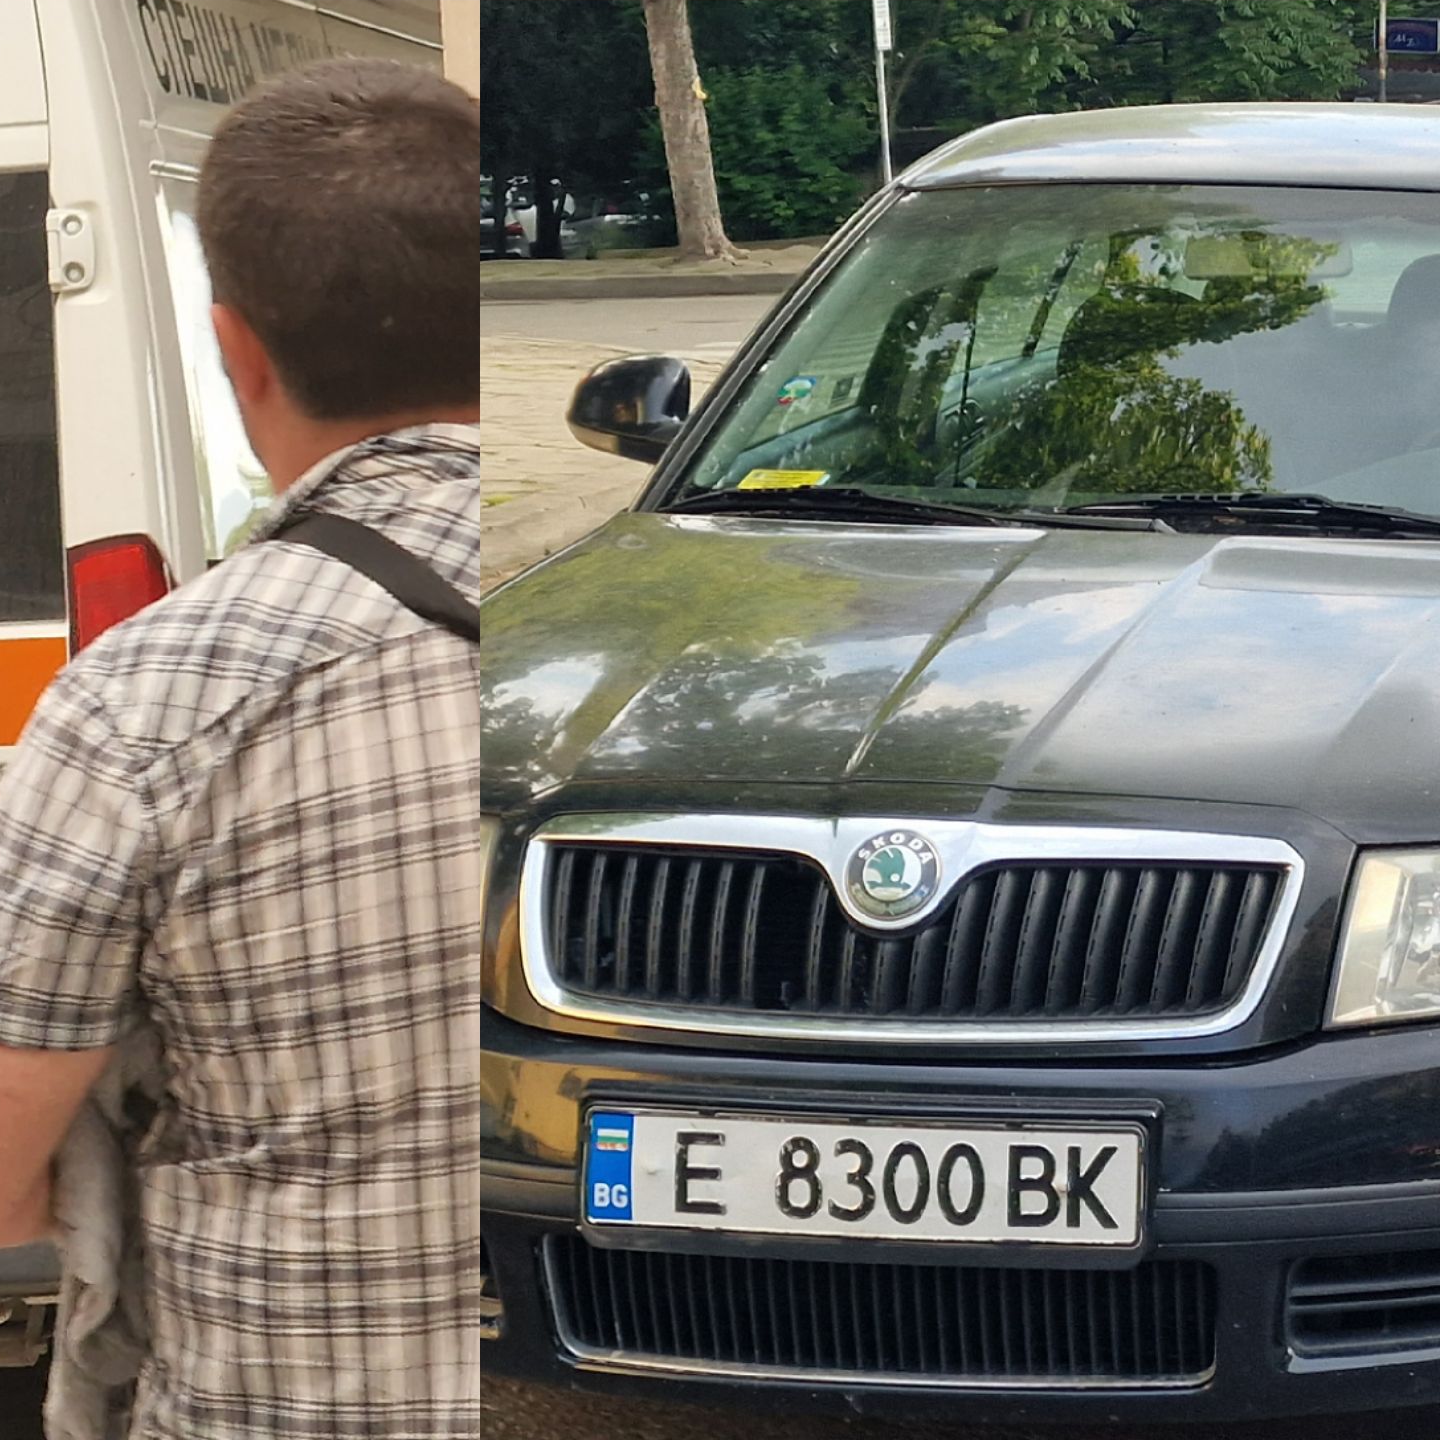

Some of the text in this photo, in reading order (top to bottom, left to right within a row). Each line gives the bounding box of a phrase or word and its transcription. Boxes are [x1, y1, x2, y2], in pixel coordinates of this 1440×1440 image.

[593, 1182, 629, 1208] BG
[674, 1130, 1120, 1230] E 8300 BK
